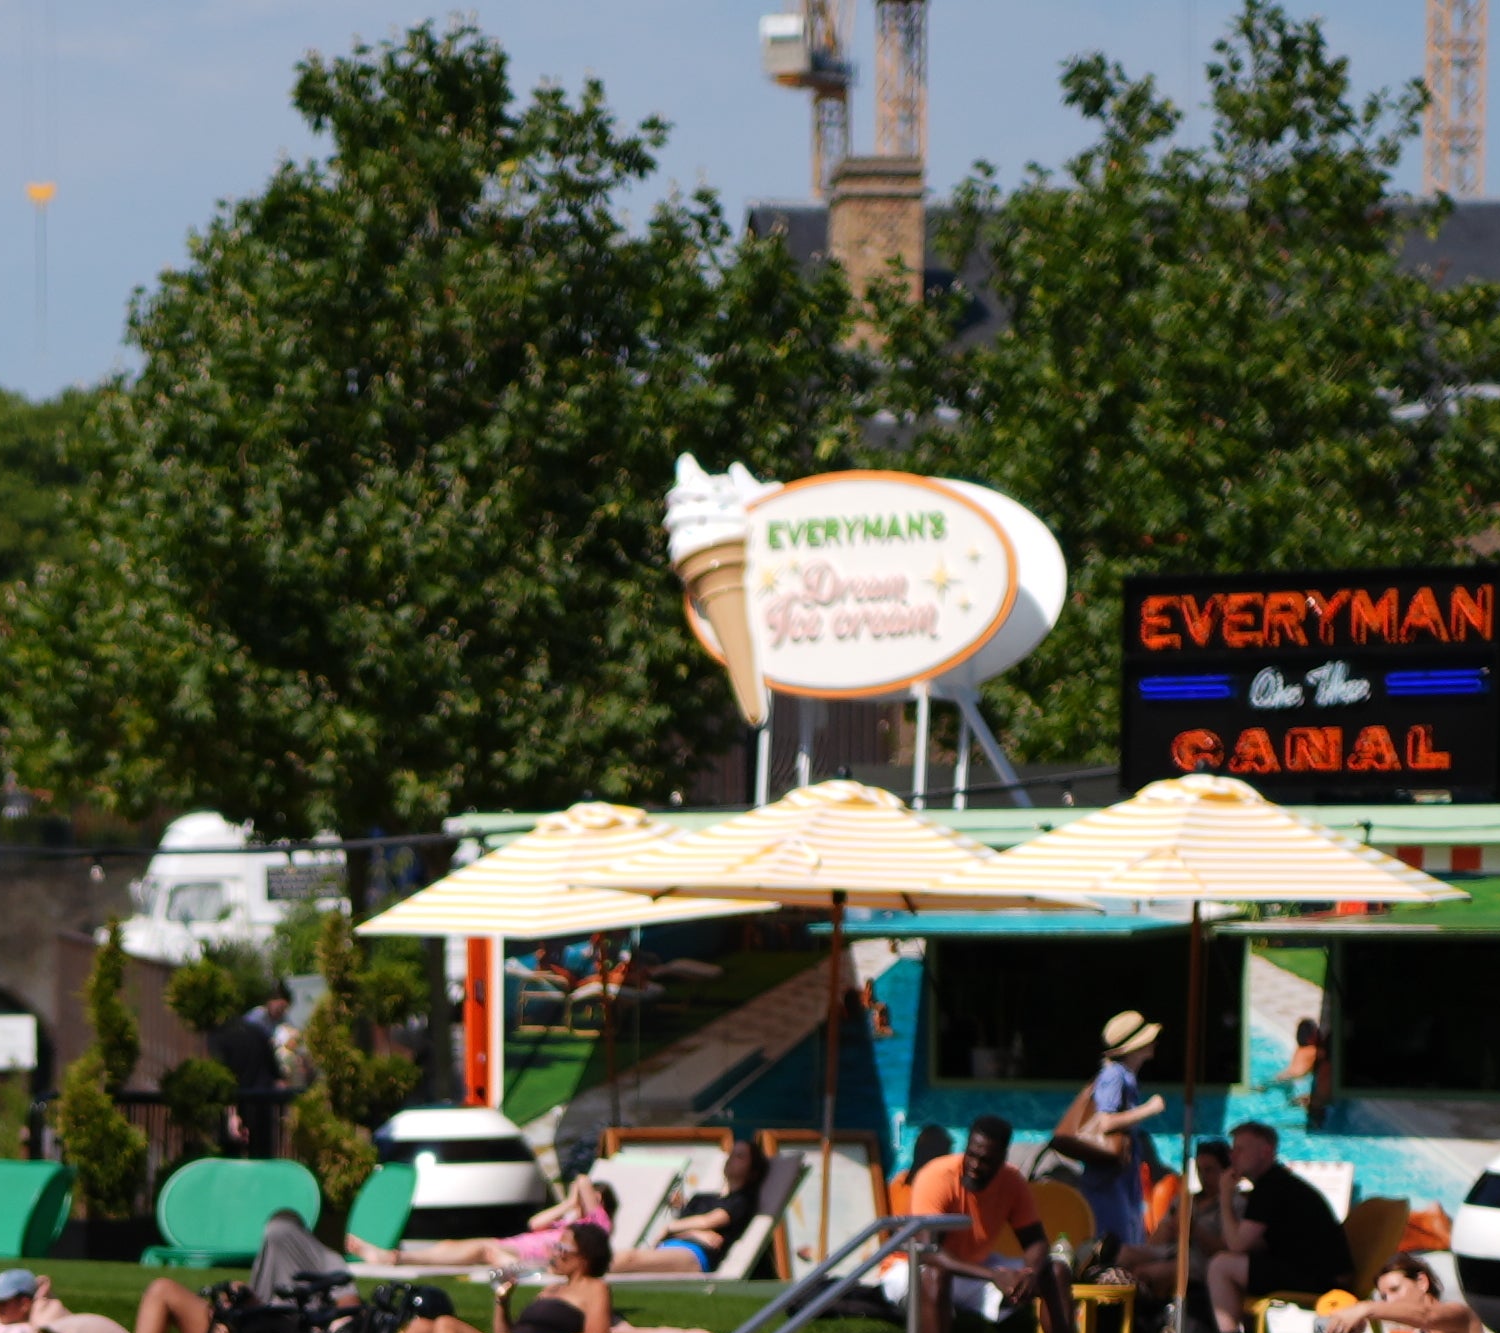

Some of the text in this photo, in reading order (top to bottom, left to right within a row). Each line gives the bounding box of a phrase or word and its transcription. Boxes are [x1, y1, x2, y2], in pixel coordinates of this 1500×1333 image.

[1139, 583, 1495, 650] EVERYMAN
[1249, 666, 1305, 709] On
[1170, 725, 1452, 773] CANAL
